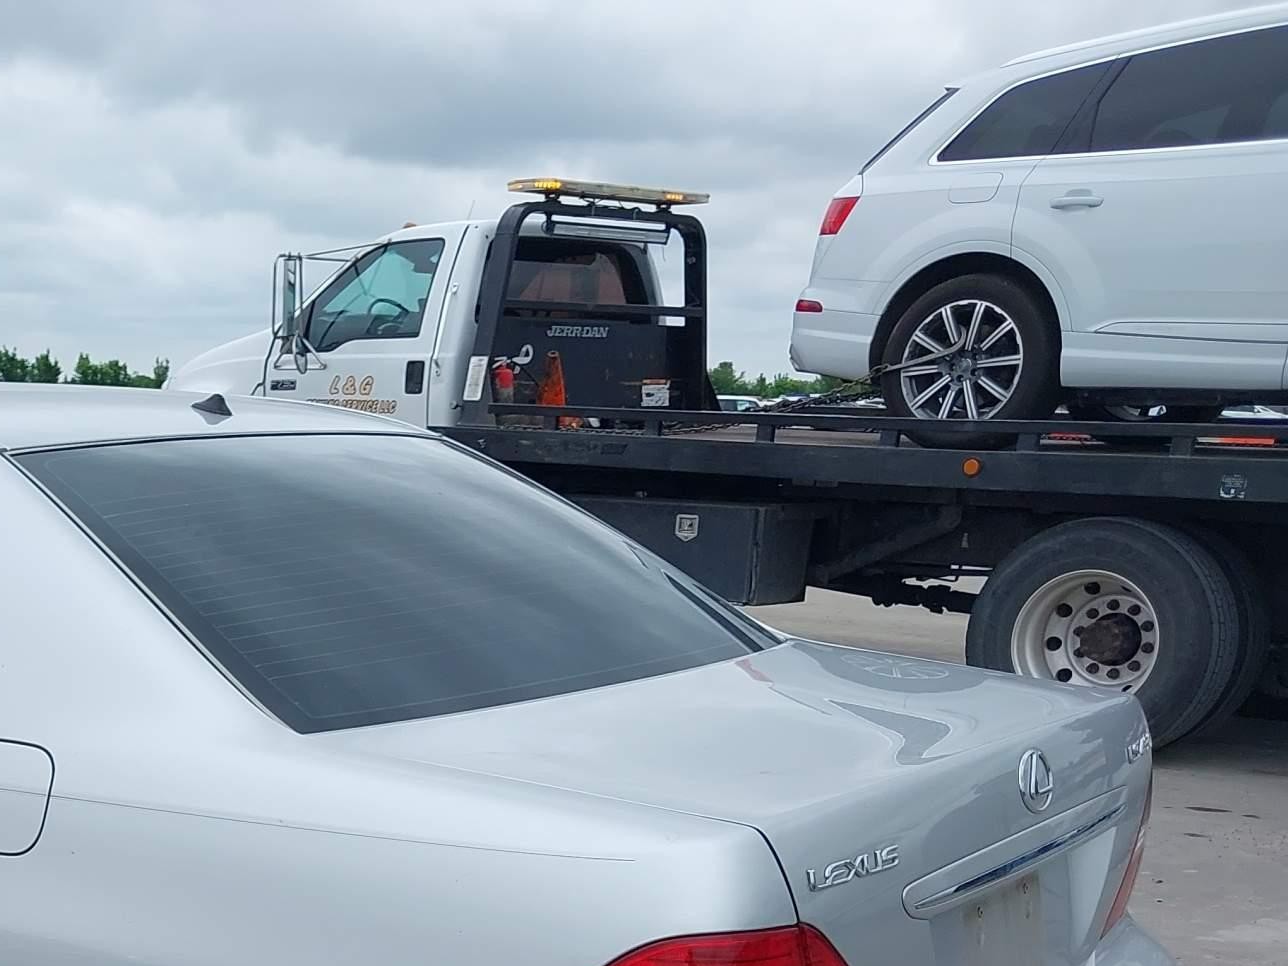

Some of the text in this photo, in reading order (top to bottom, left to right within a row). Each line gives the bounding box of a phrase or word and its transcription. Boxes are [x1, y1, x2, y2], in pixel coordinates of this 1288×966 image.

[329, 375, 374, 395] L & G
[378, 400, 397, 414] LLC
[806, 844, 900, 892] LEXUS
